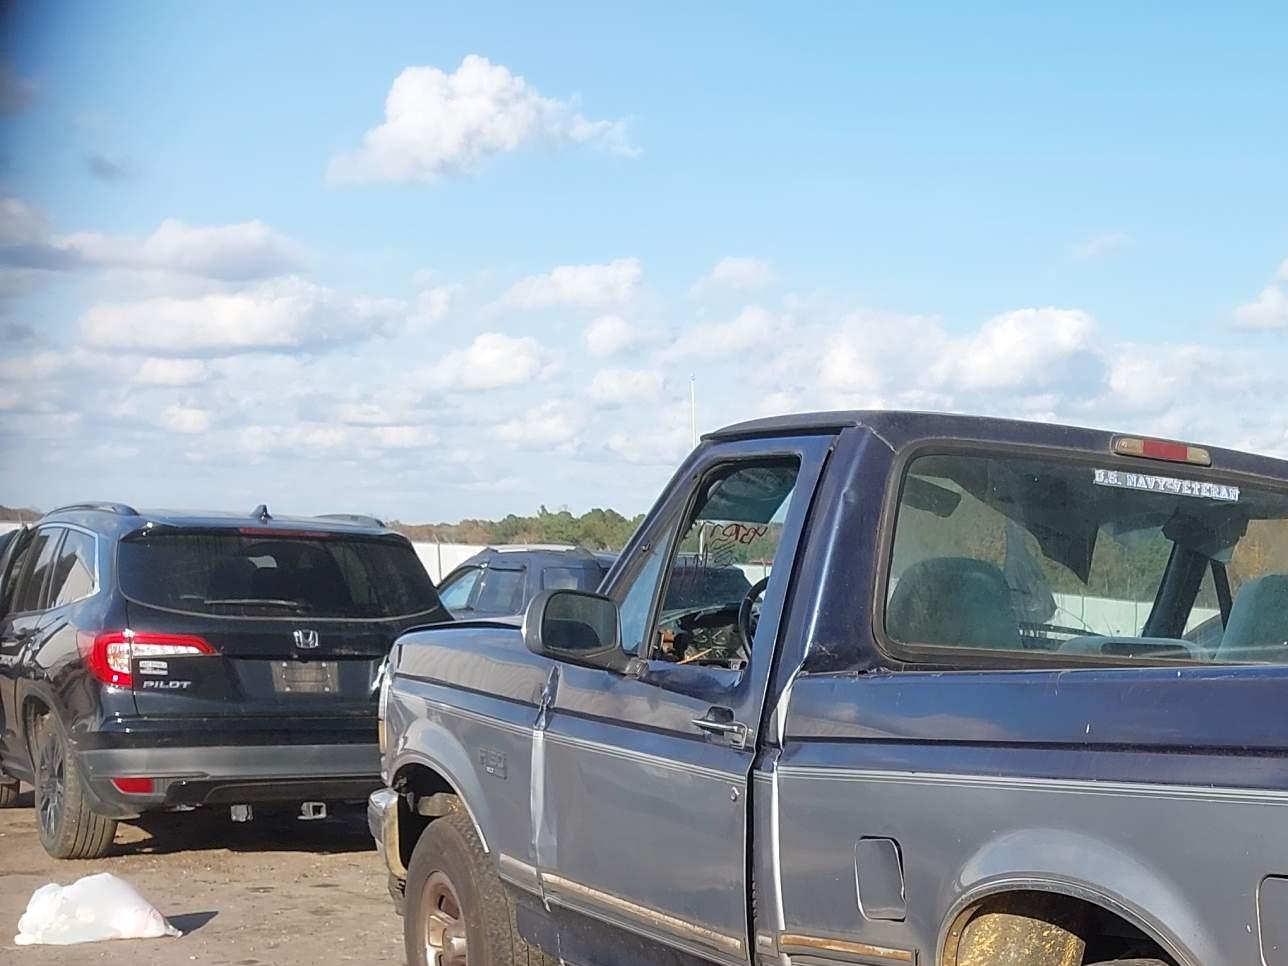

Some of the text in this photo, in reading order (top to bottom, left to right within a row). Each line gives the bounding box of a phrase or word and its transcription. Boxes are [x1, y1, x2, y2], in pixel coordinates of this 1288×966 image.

[1094, 468, 1240, 501] U.S. NAVY VETERAN
[143, 680, 192, 689] PILOT
